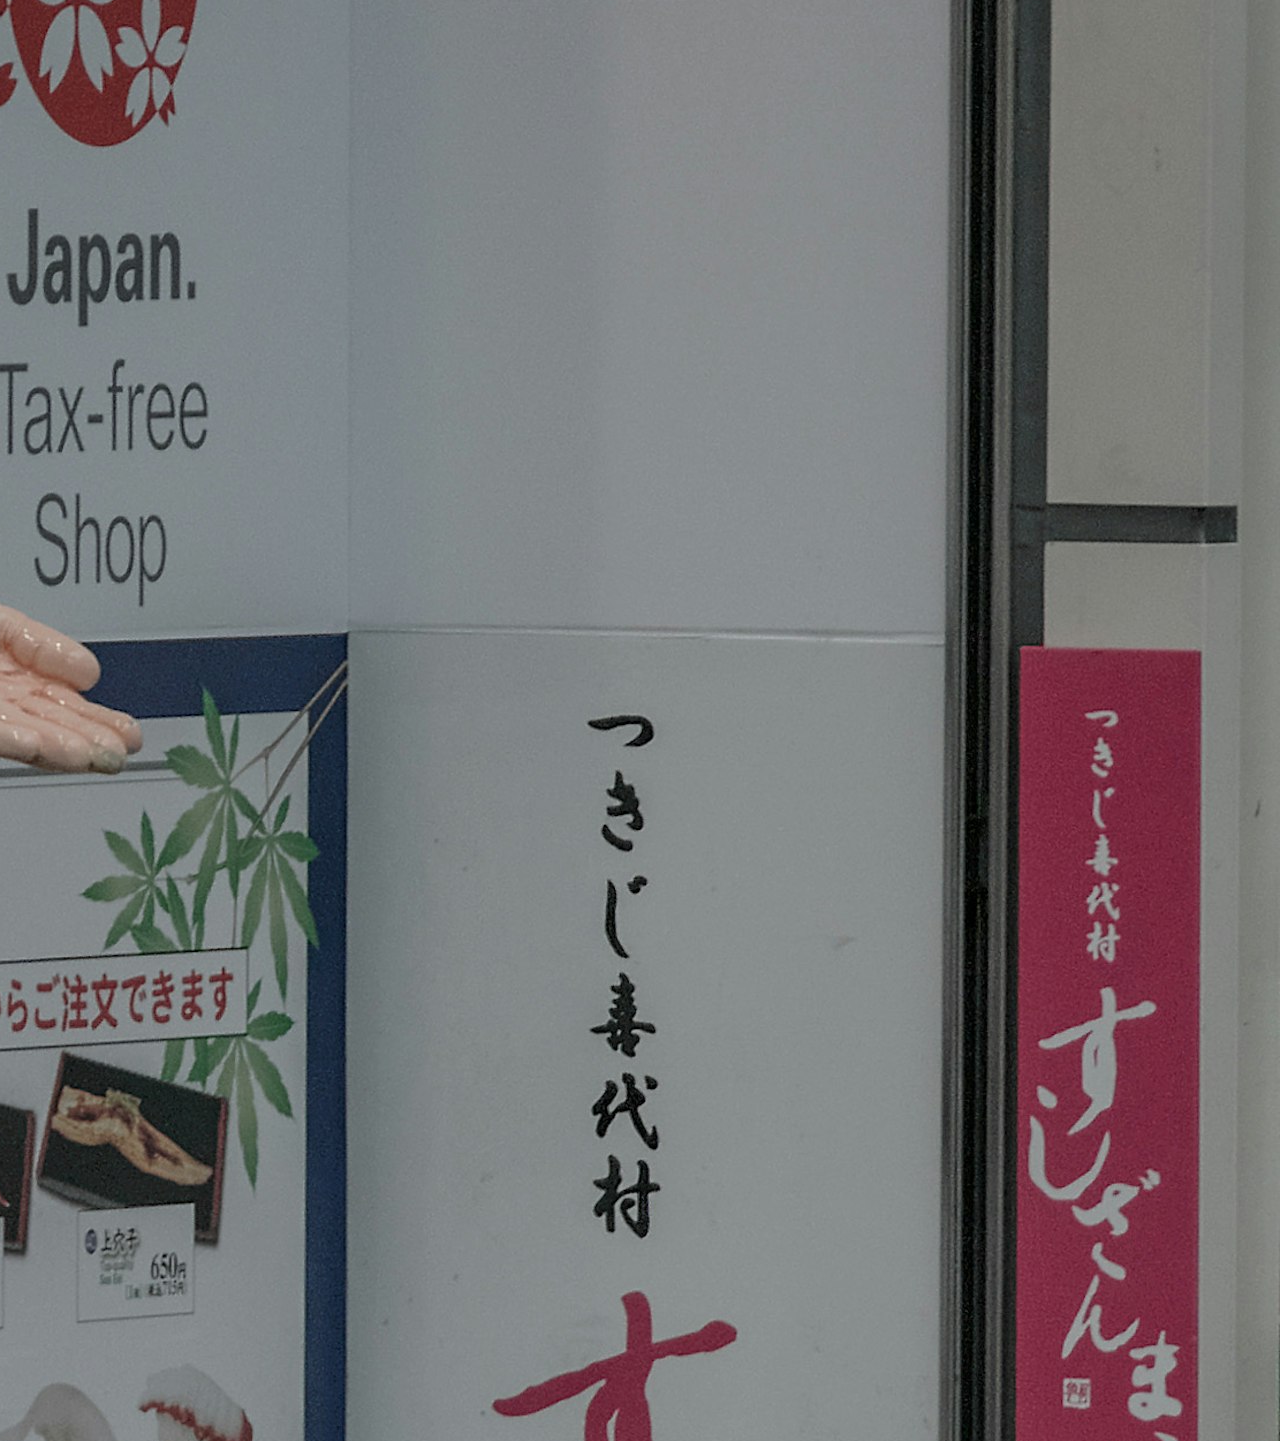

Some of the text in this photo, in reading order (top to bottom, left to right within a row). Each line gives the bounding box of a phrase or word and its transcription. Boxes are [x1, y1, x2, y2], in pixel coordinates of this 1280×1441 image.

[5, 209, 198, 327] Japan.
[33, 495, 168, 606] Shop
[1084, 709, 1123, 963] つきじ喜代村
[586, 711, 660, 1238] つきじ喜代村
[150, 1252, 186, 1280] 650円
